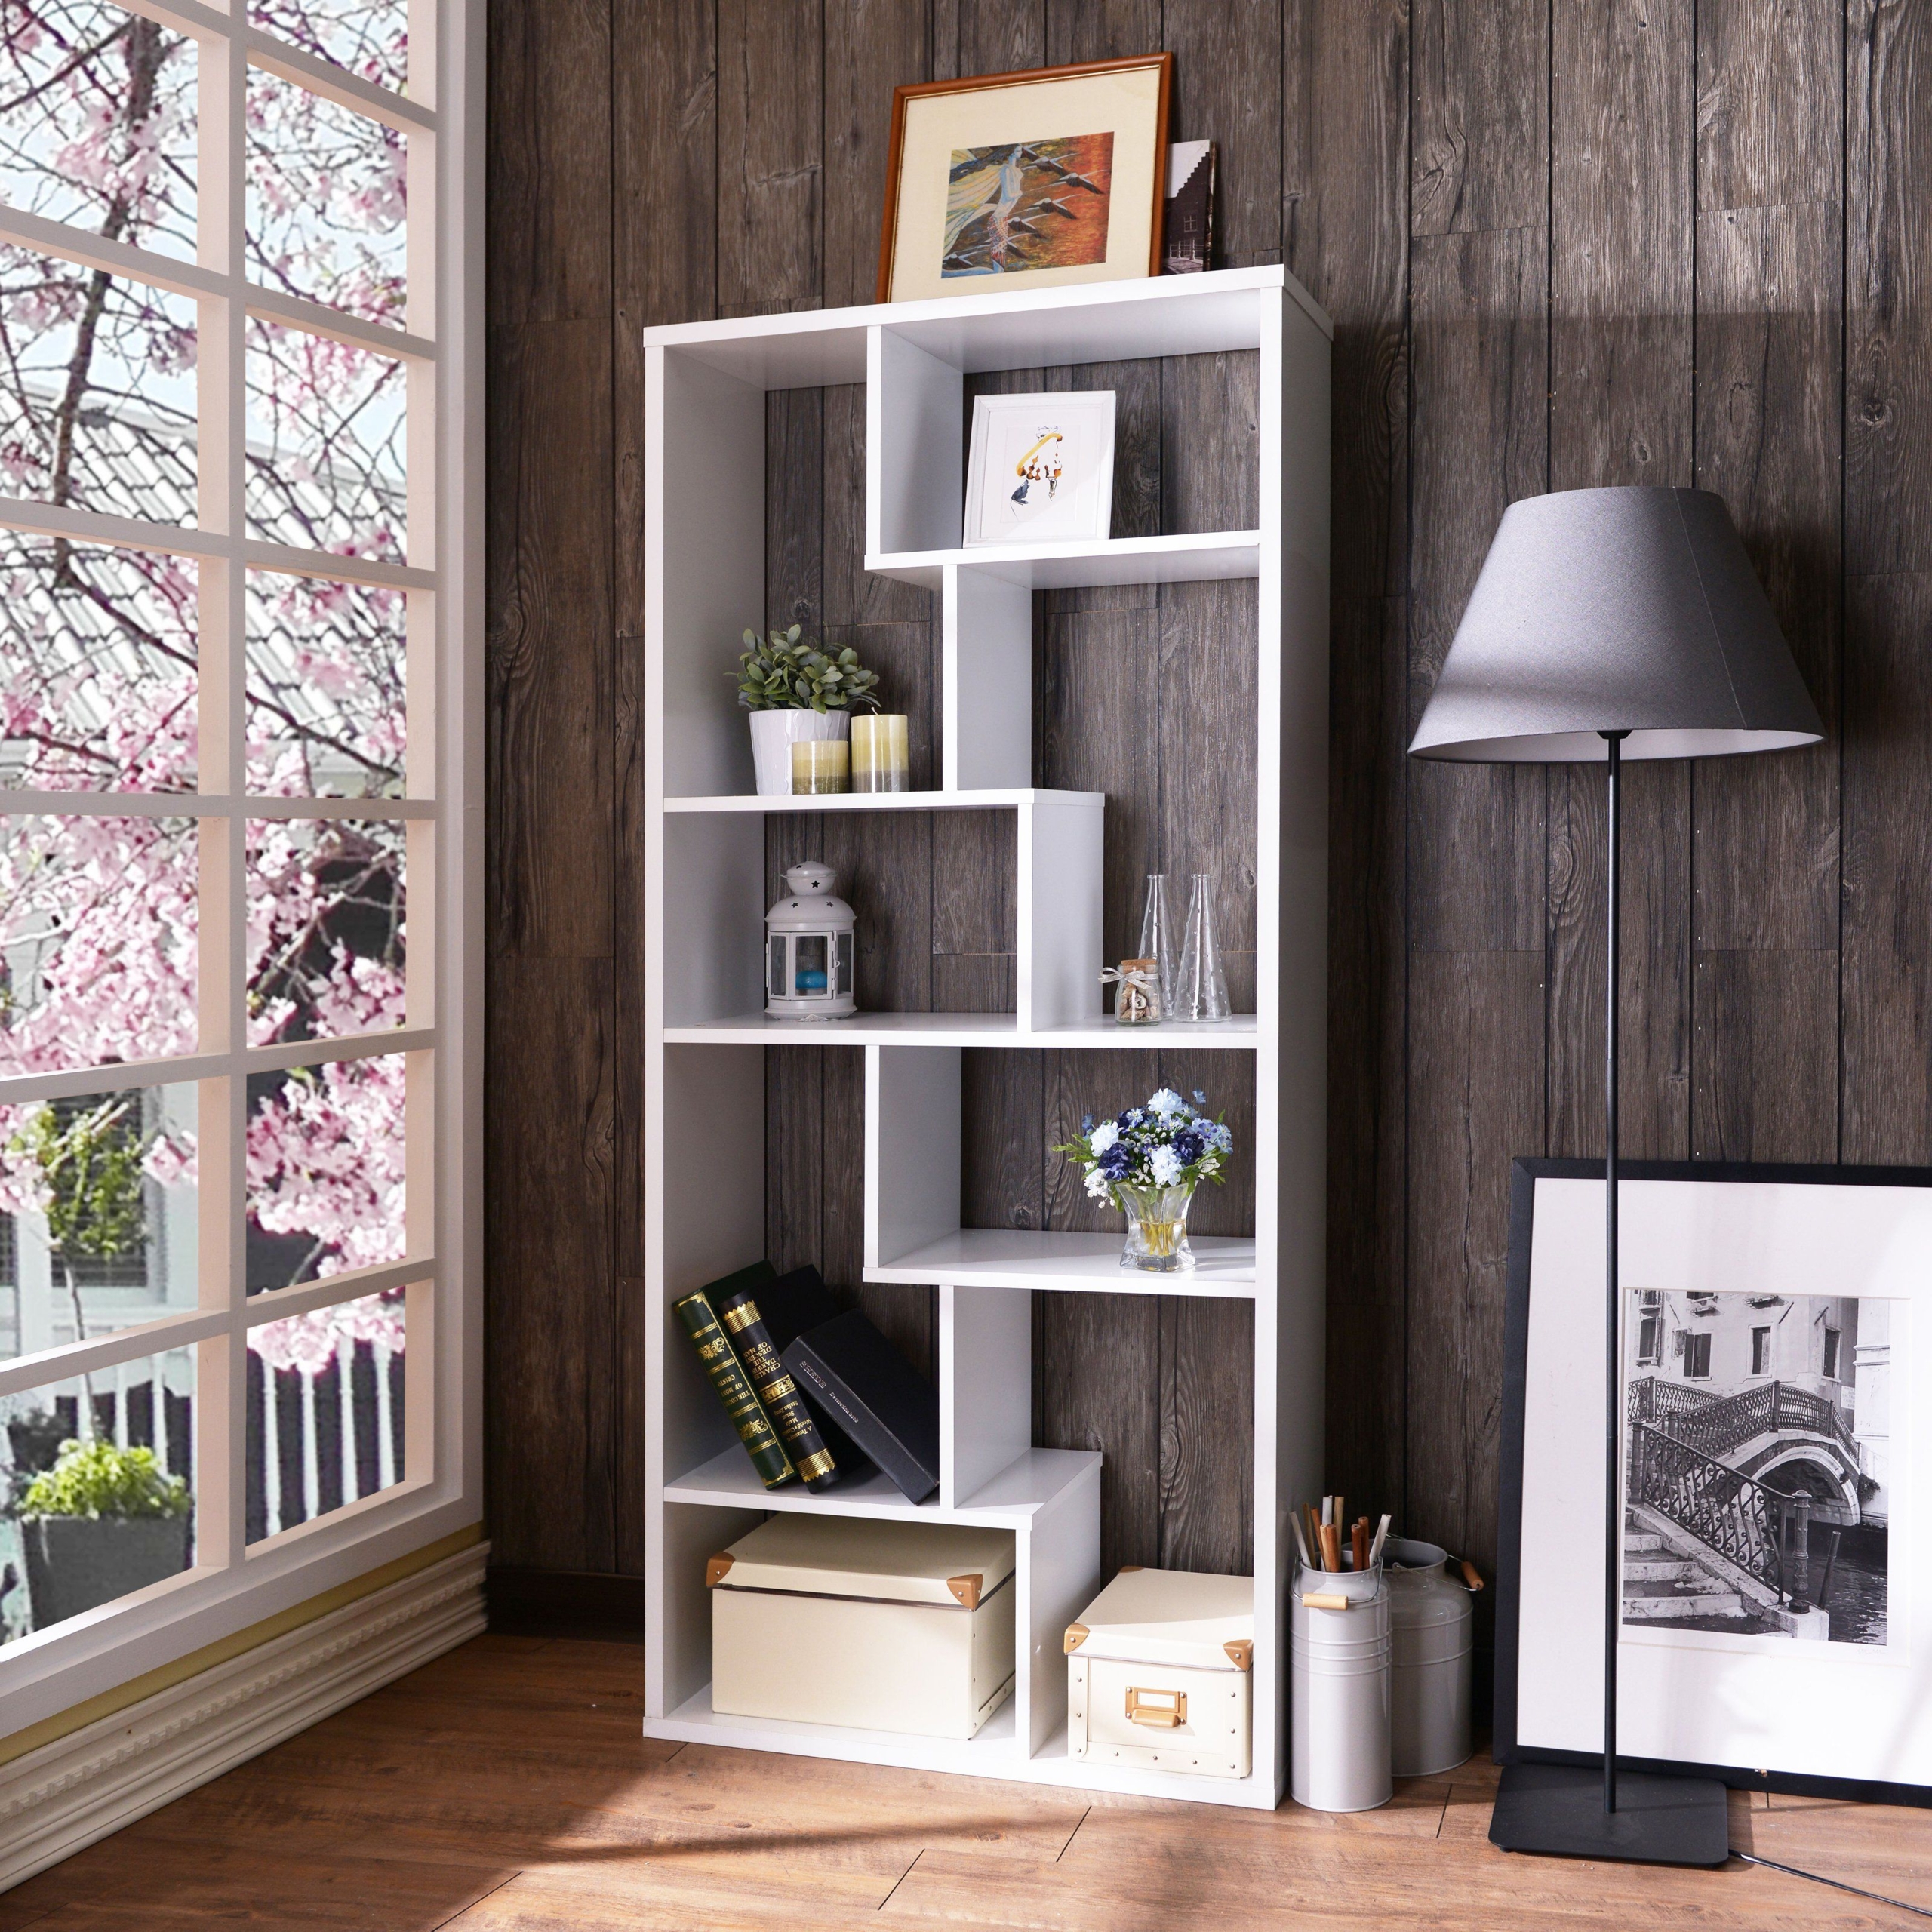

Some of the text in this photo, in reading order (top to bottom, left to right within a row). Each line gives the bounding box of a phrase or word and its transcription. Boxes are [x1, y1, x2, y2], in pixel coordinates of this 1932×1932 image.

[743, 1340, 768, 1358] OF MAN
[745, 1345, 772, 1364] DESCENT
[751, 1357, 776, 1374] DARWIN
[752, 1355, 766, 1366] THE
[752, 1361, 781, 1380] CHARLES
[798, 1360, 827, 1389] SHEDE
[716, 1374, 736, 1387] CRISTO
[734, 1381, 743, 1390] OF
[737, 1389, 750, 1399] THE
[794, 1417, 812, 1430] World's
